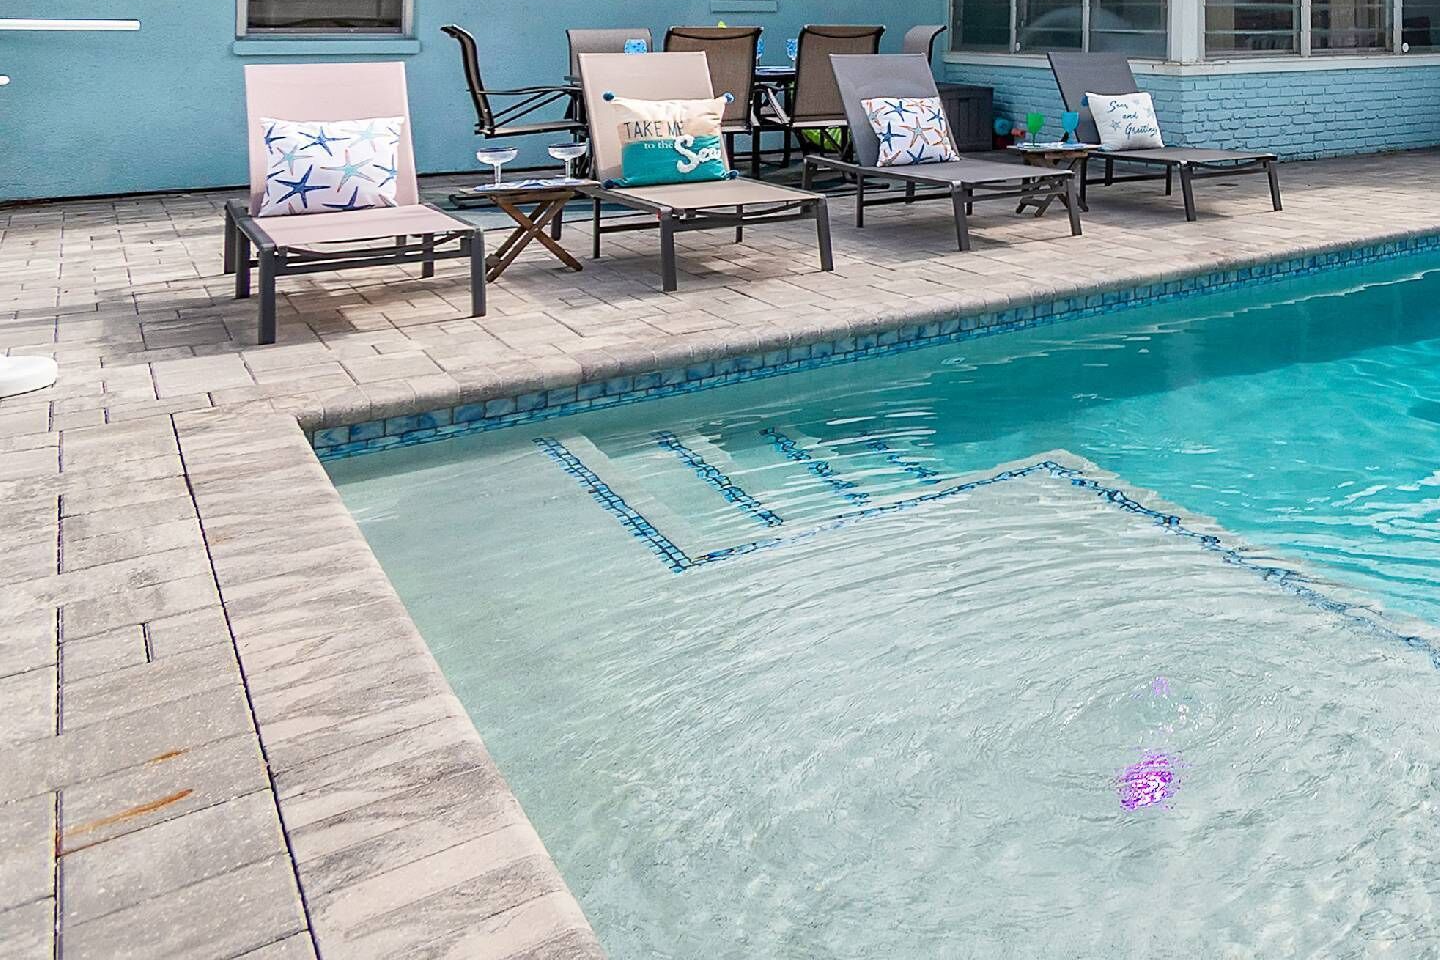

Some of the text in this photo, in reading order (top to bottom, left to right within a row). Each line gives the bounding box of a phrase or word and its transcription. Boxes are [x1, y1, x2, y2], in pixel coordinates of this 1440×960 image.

[1122, 111, 1138, 120] and
[623, 119, 686, 139] TAKE ME
[657, 140, 673, 149] the
